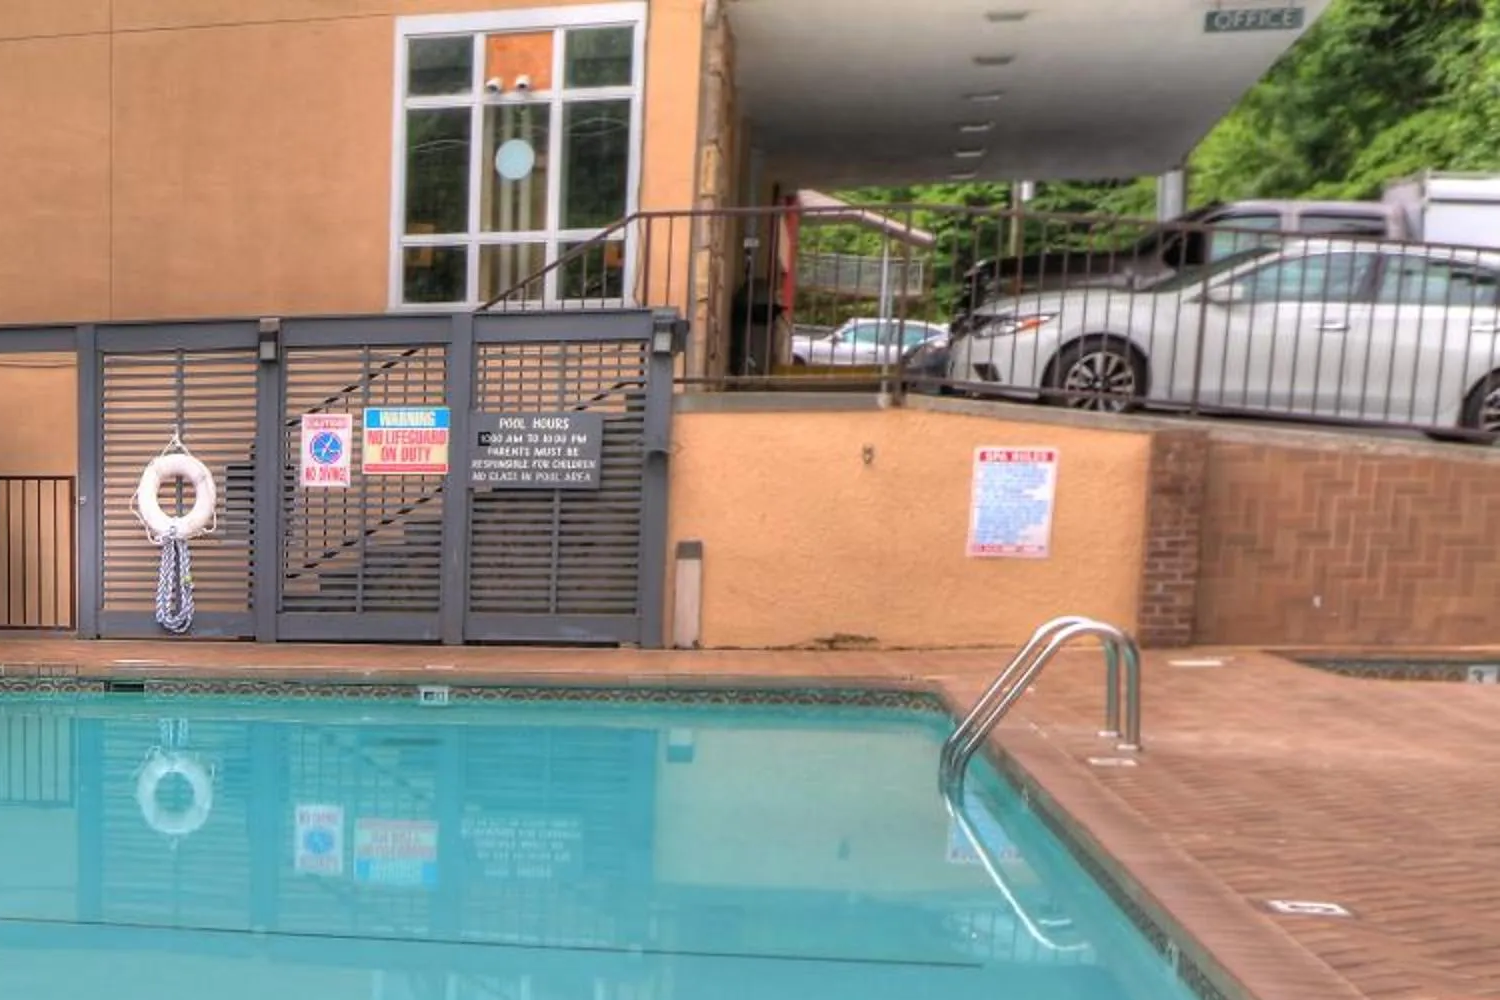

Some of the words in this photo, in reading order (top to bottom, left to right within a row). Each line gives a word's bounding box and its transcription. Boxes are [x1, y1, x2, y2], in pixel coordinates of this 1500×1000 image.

[1214, 11, 1295, 29] OFFICE
[379, 410, 436, 427] WARNING
[499, 417, 526, 429] POOL
[532, 417, 570, 430] HOURS
[368, 430, 383, 444] NO
[386, 430, 445, 444] LIFEGUARD
[505, 434, 523, 443] AM
[570, 433, 587, 443] PM
[380, 447, 397, 461] ON
[401, 447, 431, 461] DUTY
[487, 447, 530, 457] PARENTS
[533, 447, 561, 457] MUST
[566, 447, 579, 457] BE
[531, 459, 550, 469] FOR
[472, 471, 486, 481] NO
